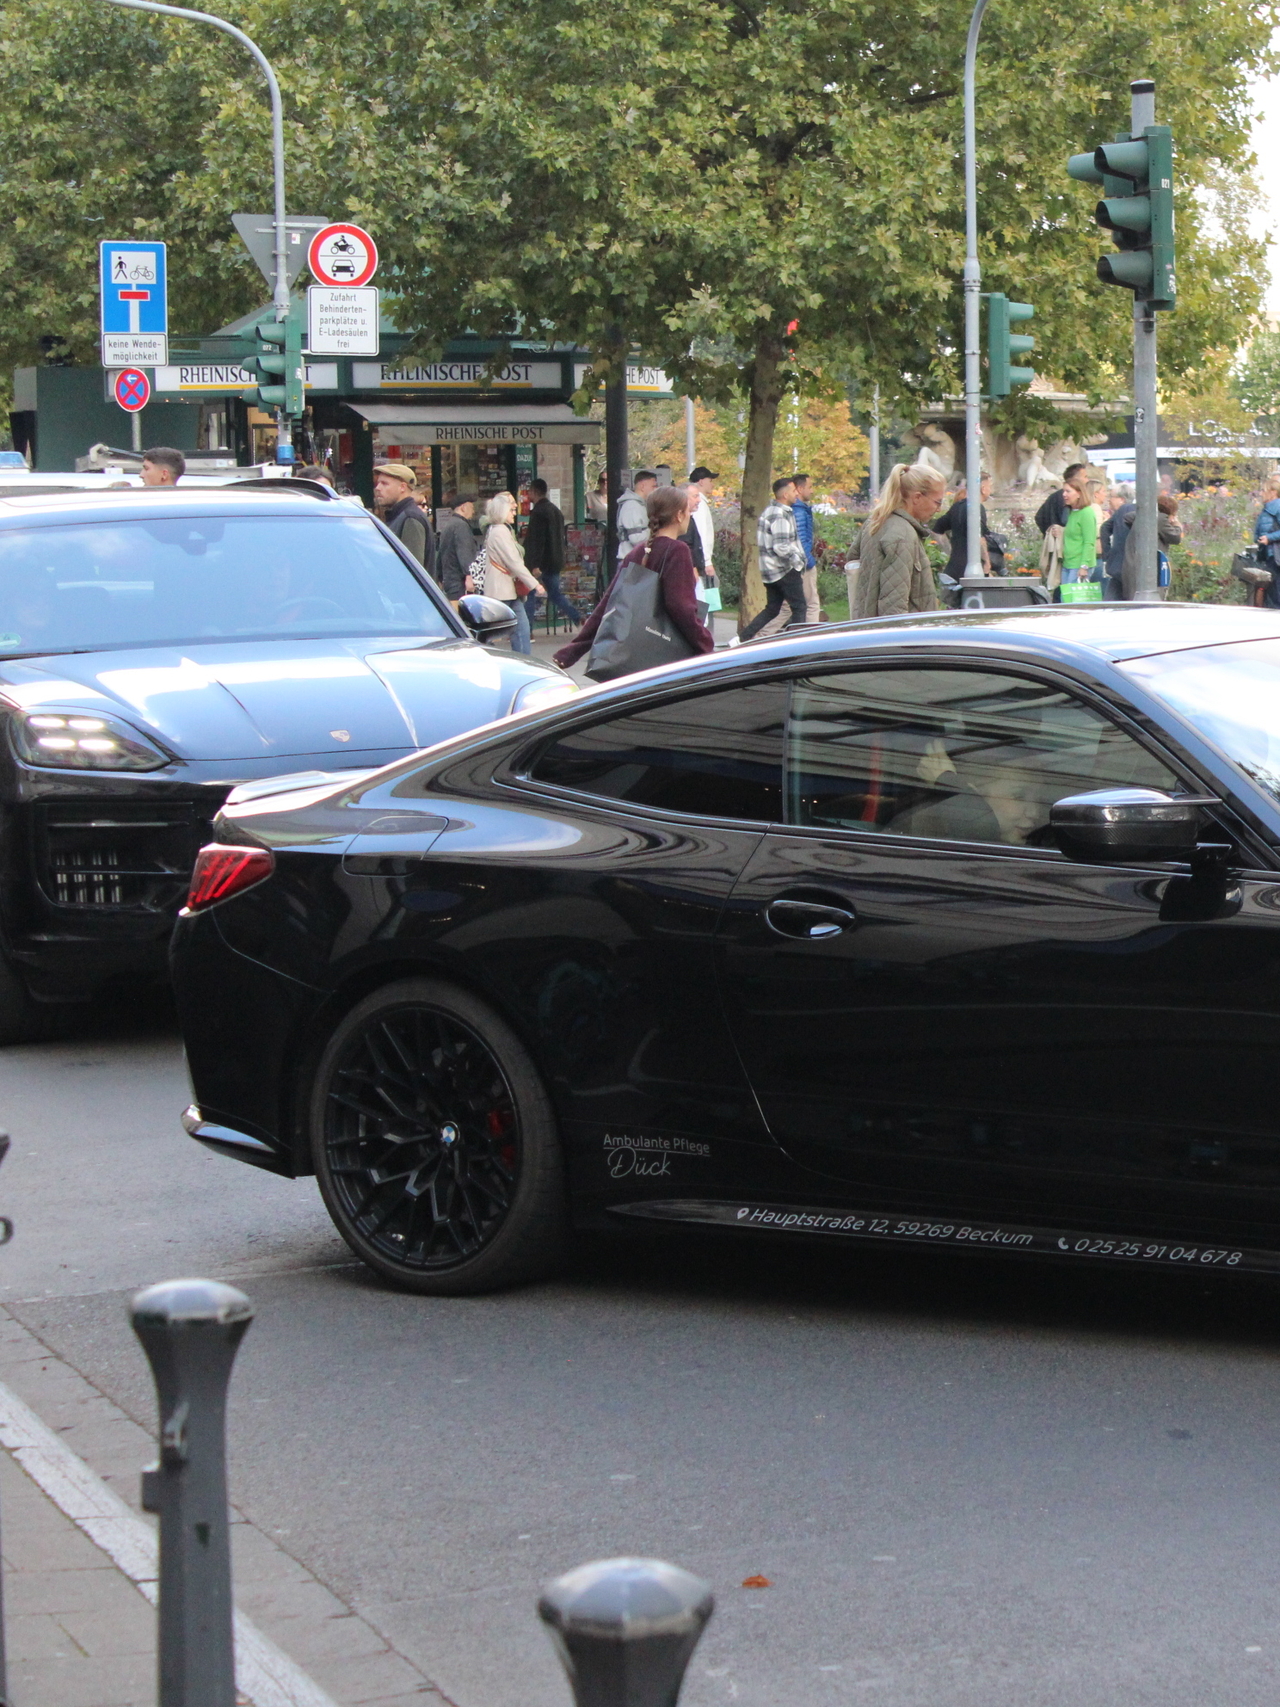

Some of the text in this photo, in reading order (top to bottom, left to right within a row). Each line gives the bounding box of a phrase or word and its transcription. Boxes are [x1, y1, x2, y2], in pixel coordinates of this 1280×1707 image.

[330, 293, 356, 302] Zufahrt
[320, 304, 367, 313] Behinderten-
[320, 316, 357, 326] parkplätze
[319, 328, 368, 337] E-Ladesäulen
[108, 339, 161, 348] keine Wende-
[337, 340, 349, 348] frei
[113, 352, 158, 362] möglichkeit
[180, 366, 257, 383] RHEINISC
[488, 364, 532, 381] OST
[436, 427, 545, 440] RHEINISCHE POST
[603, 1133, 710, 1154] Ambulante Pflege
[607, 1146, 671, 1178] Dück
[750, 1208, 1033, 1245] Hauptstraße 12, 59269 Beckum
[1200, 1249, 1242, 1265] 678
